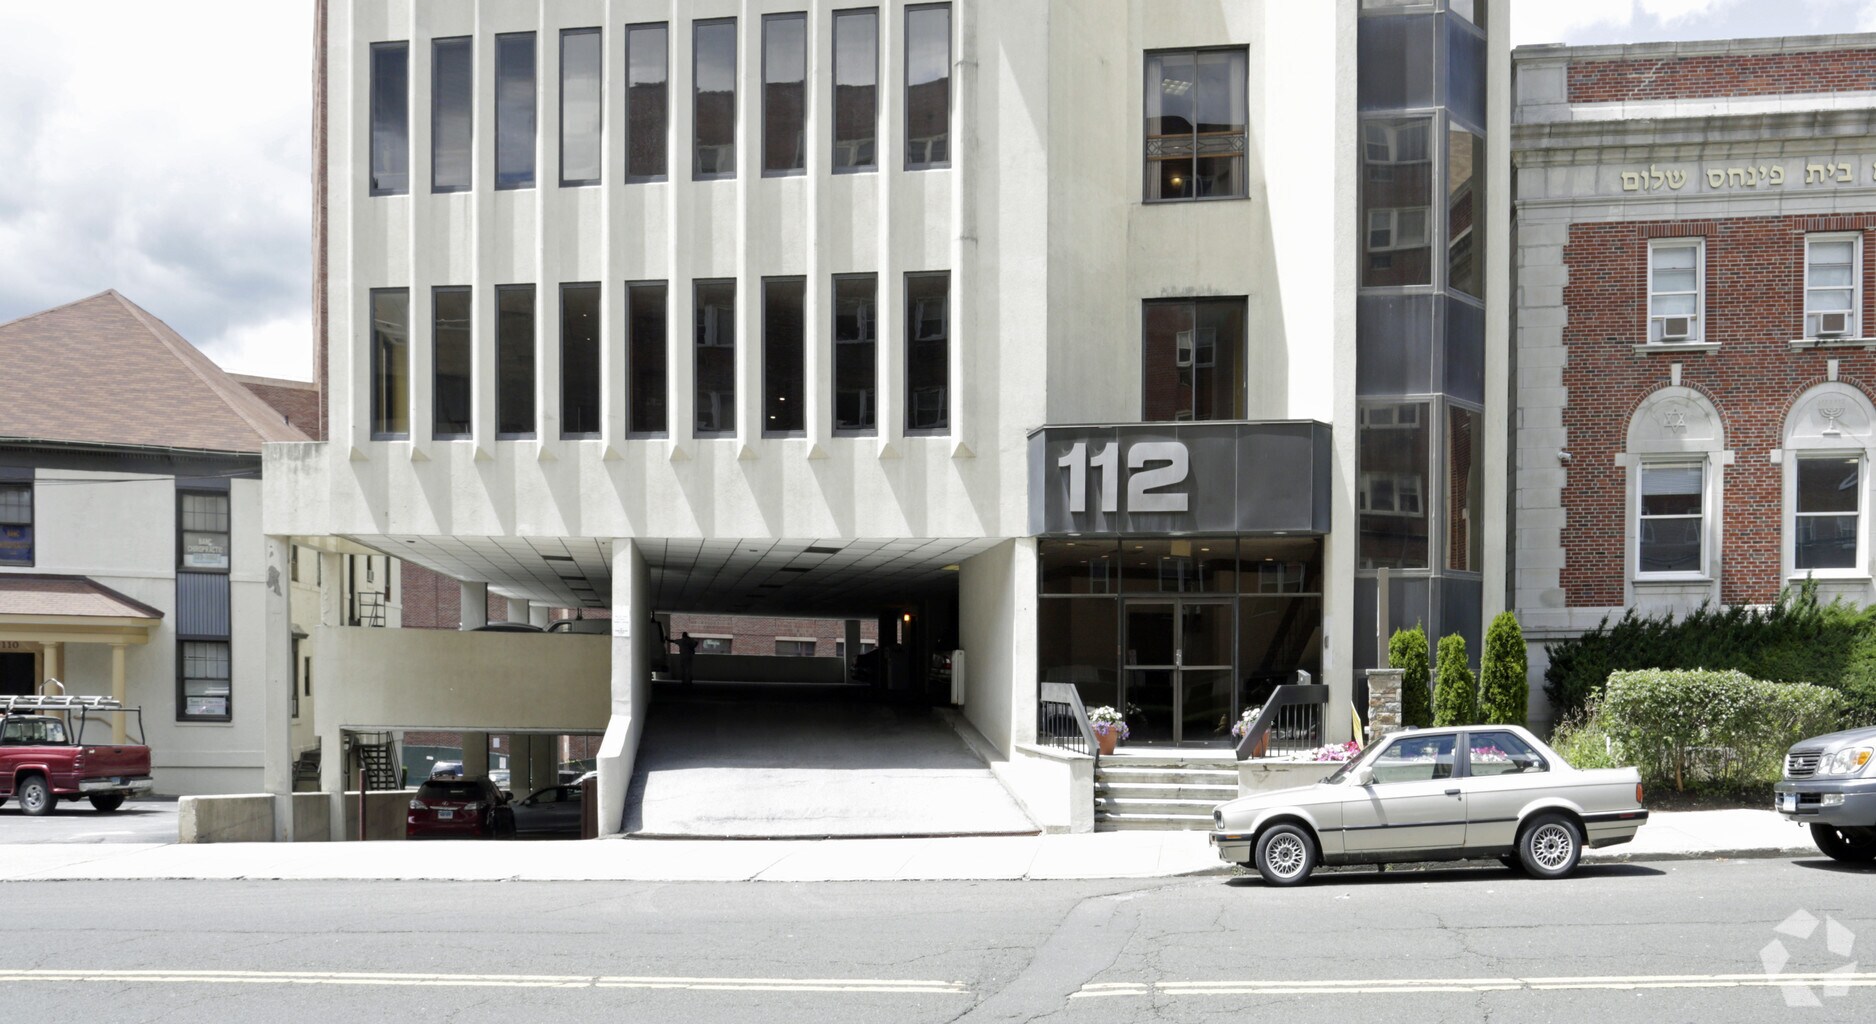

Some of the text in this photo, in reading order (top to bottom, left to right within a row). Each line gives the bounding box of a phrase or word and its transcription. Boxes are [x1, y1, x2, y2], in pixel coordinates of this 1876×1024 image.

[1621, 164, 1687, 191] שלום
[1706, 164, 1785, 188] פינחס
[1805, 160, 1853, 185] בית
[1058, 441, 1189, 512] 112
